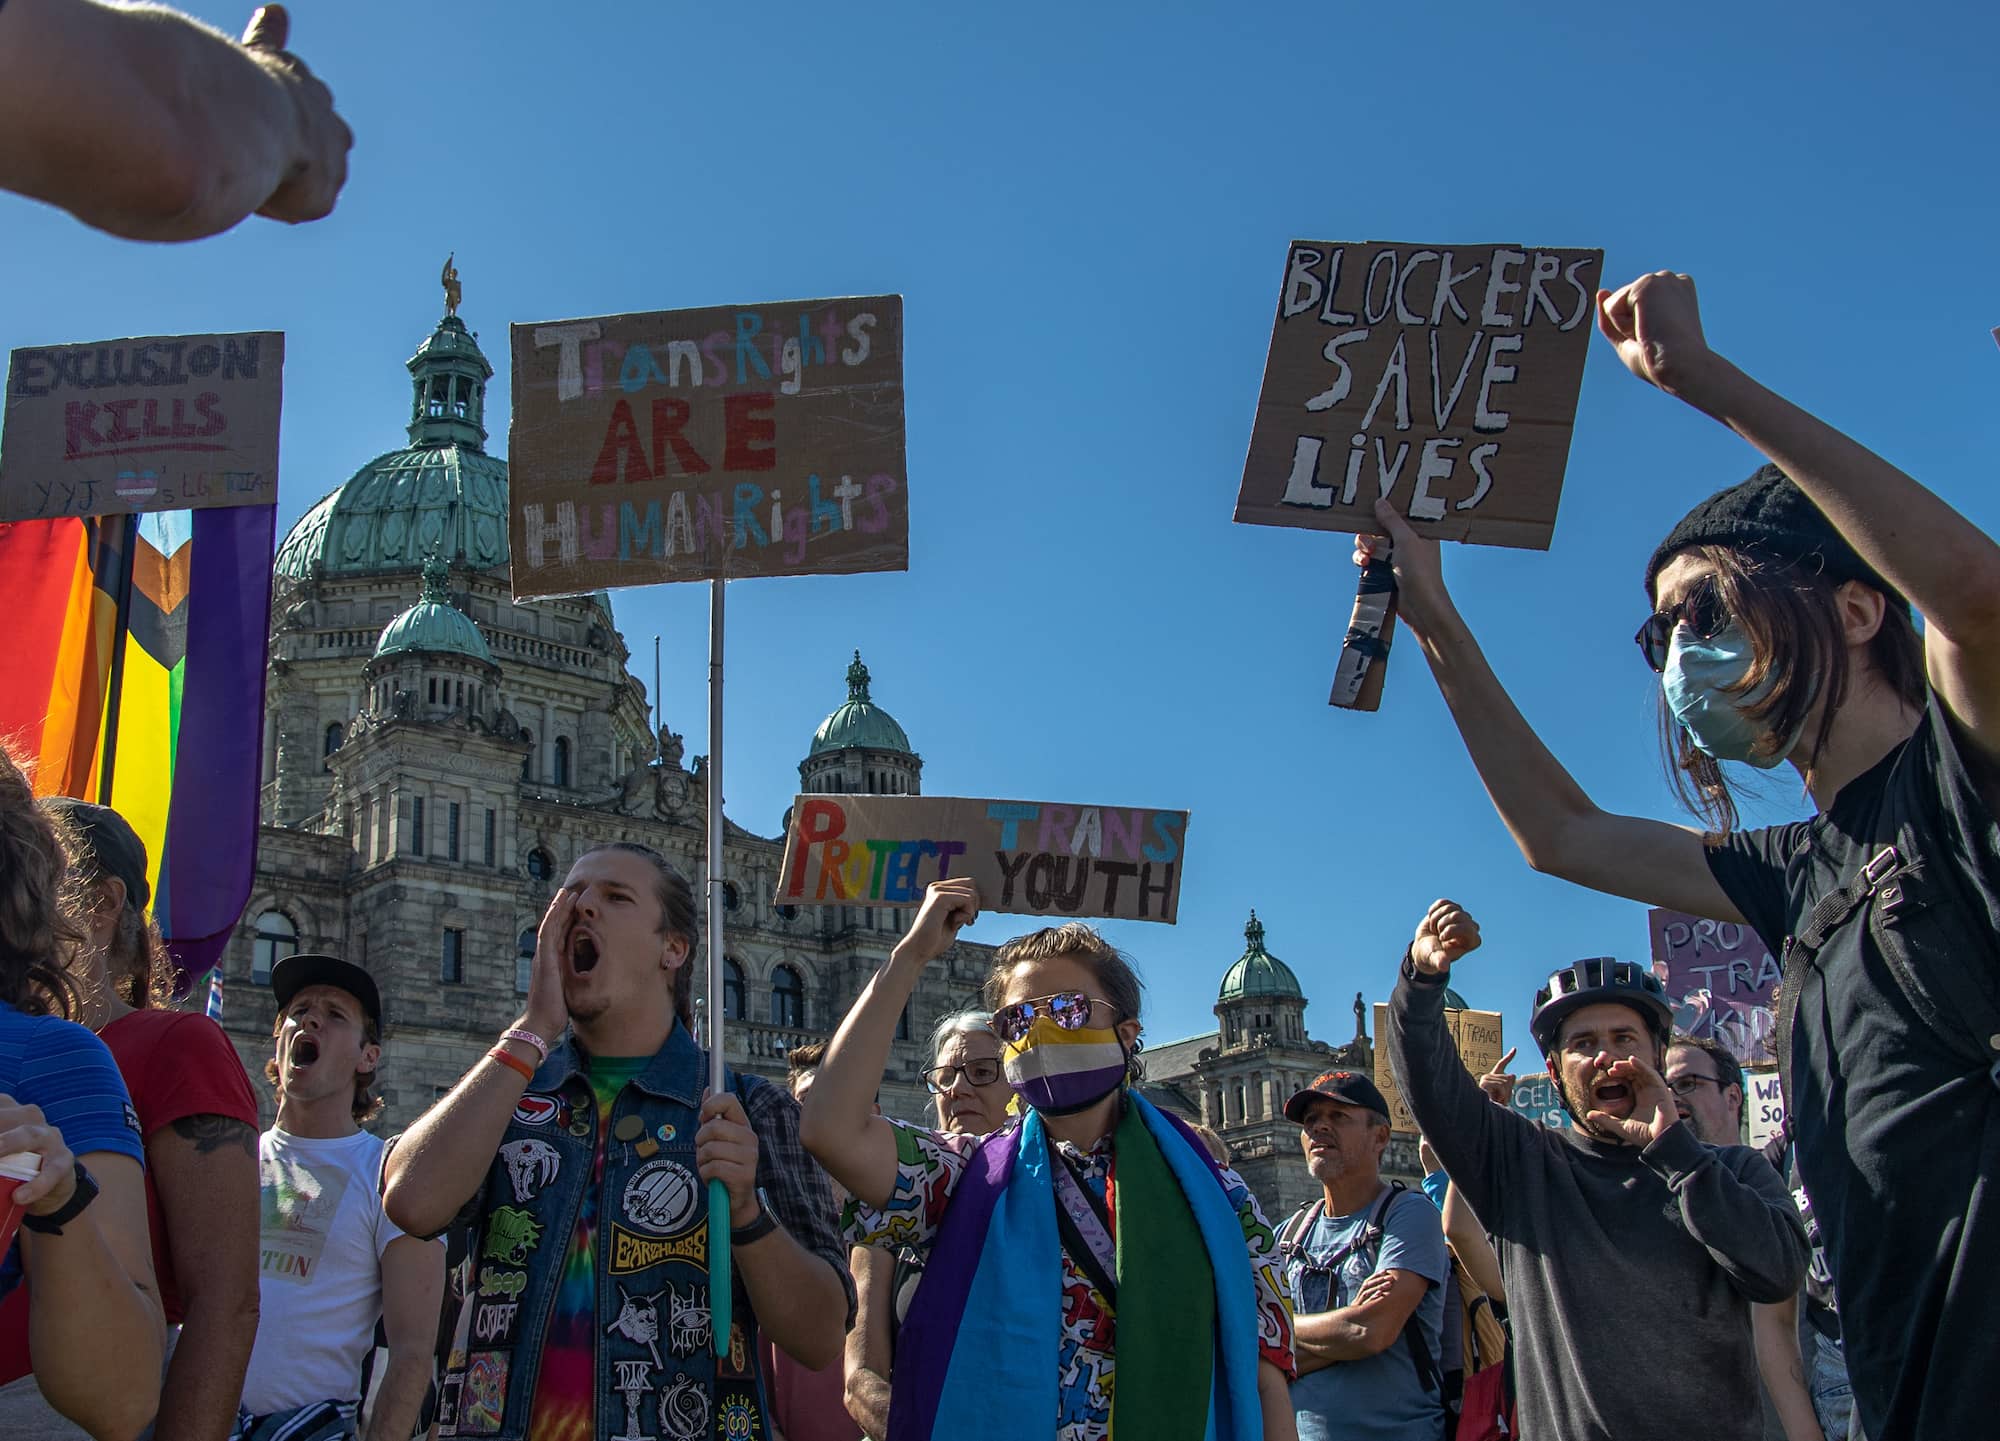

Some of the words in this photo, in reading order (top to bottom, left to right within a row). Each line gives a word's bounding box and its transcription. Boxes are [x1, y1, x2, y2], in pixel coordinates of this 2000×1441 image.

[1283, 248, 1593, 332] BLOCKERS
[1304, 328, 1524, 433] SAVE
[64, 391, 228, 455] KILLS
[589, 392, 777, 487] ARE
[787, 800, 967, 904] PROTECT
[985, 804, 1182, 863] TRANS
[994, 851, 1174, 919] YOUTH
[1664, 918, 1746, 961] PRO
